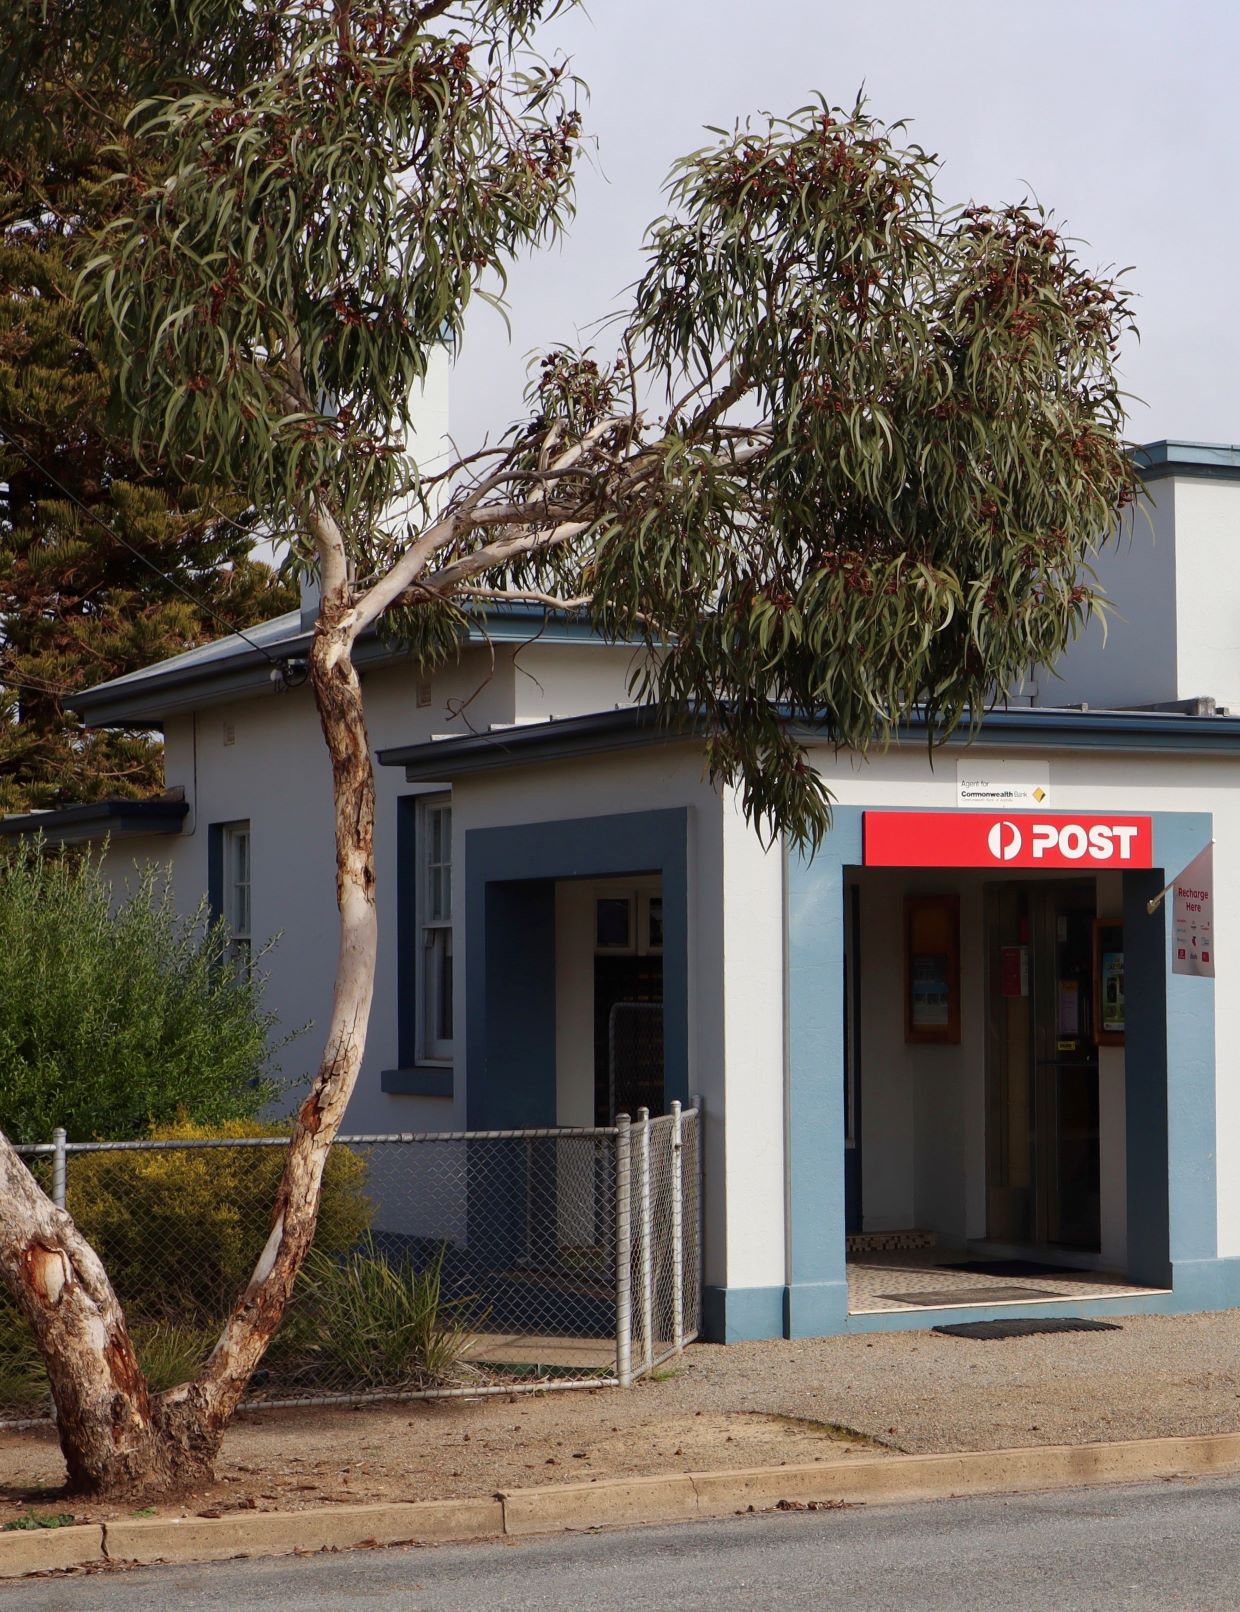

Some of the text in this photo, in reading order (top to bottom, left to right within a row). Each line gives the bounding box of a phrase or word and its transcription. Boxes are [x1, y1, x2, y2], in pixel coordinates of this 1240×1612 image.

[961, 780, 979, 788] Agent
[1032, 824, 1138, 860] POST
[1178, 888, 1208, 901] Recharge
[1186, 902, 1201, 912] Here
